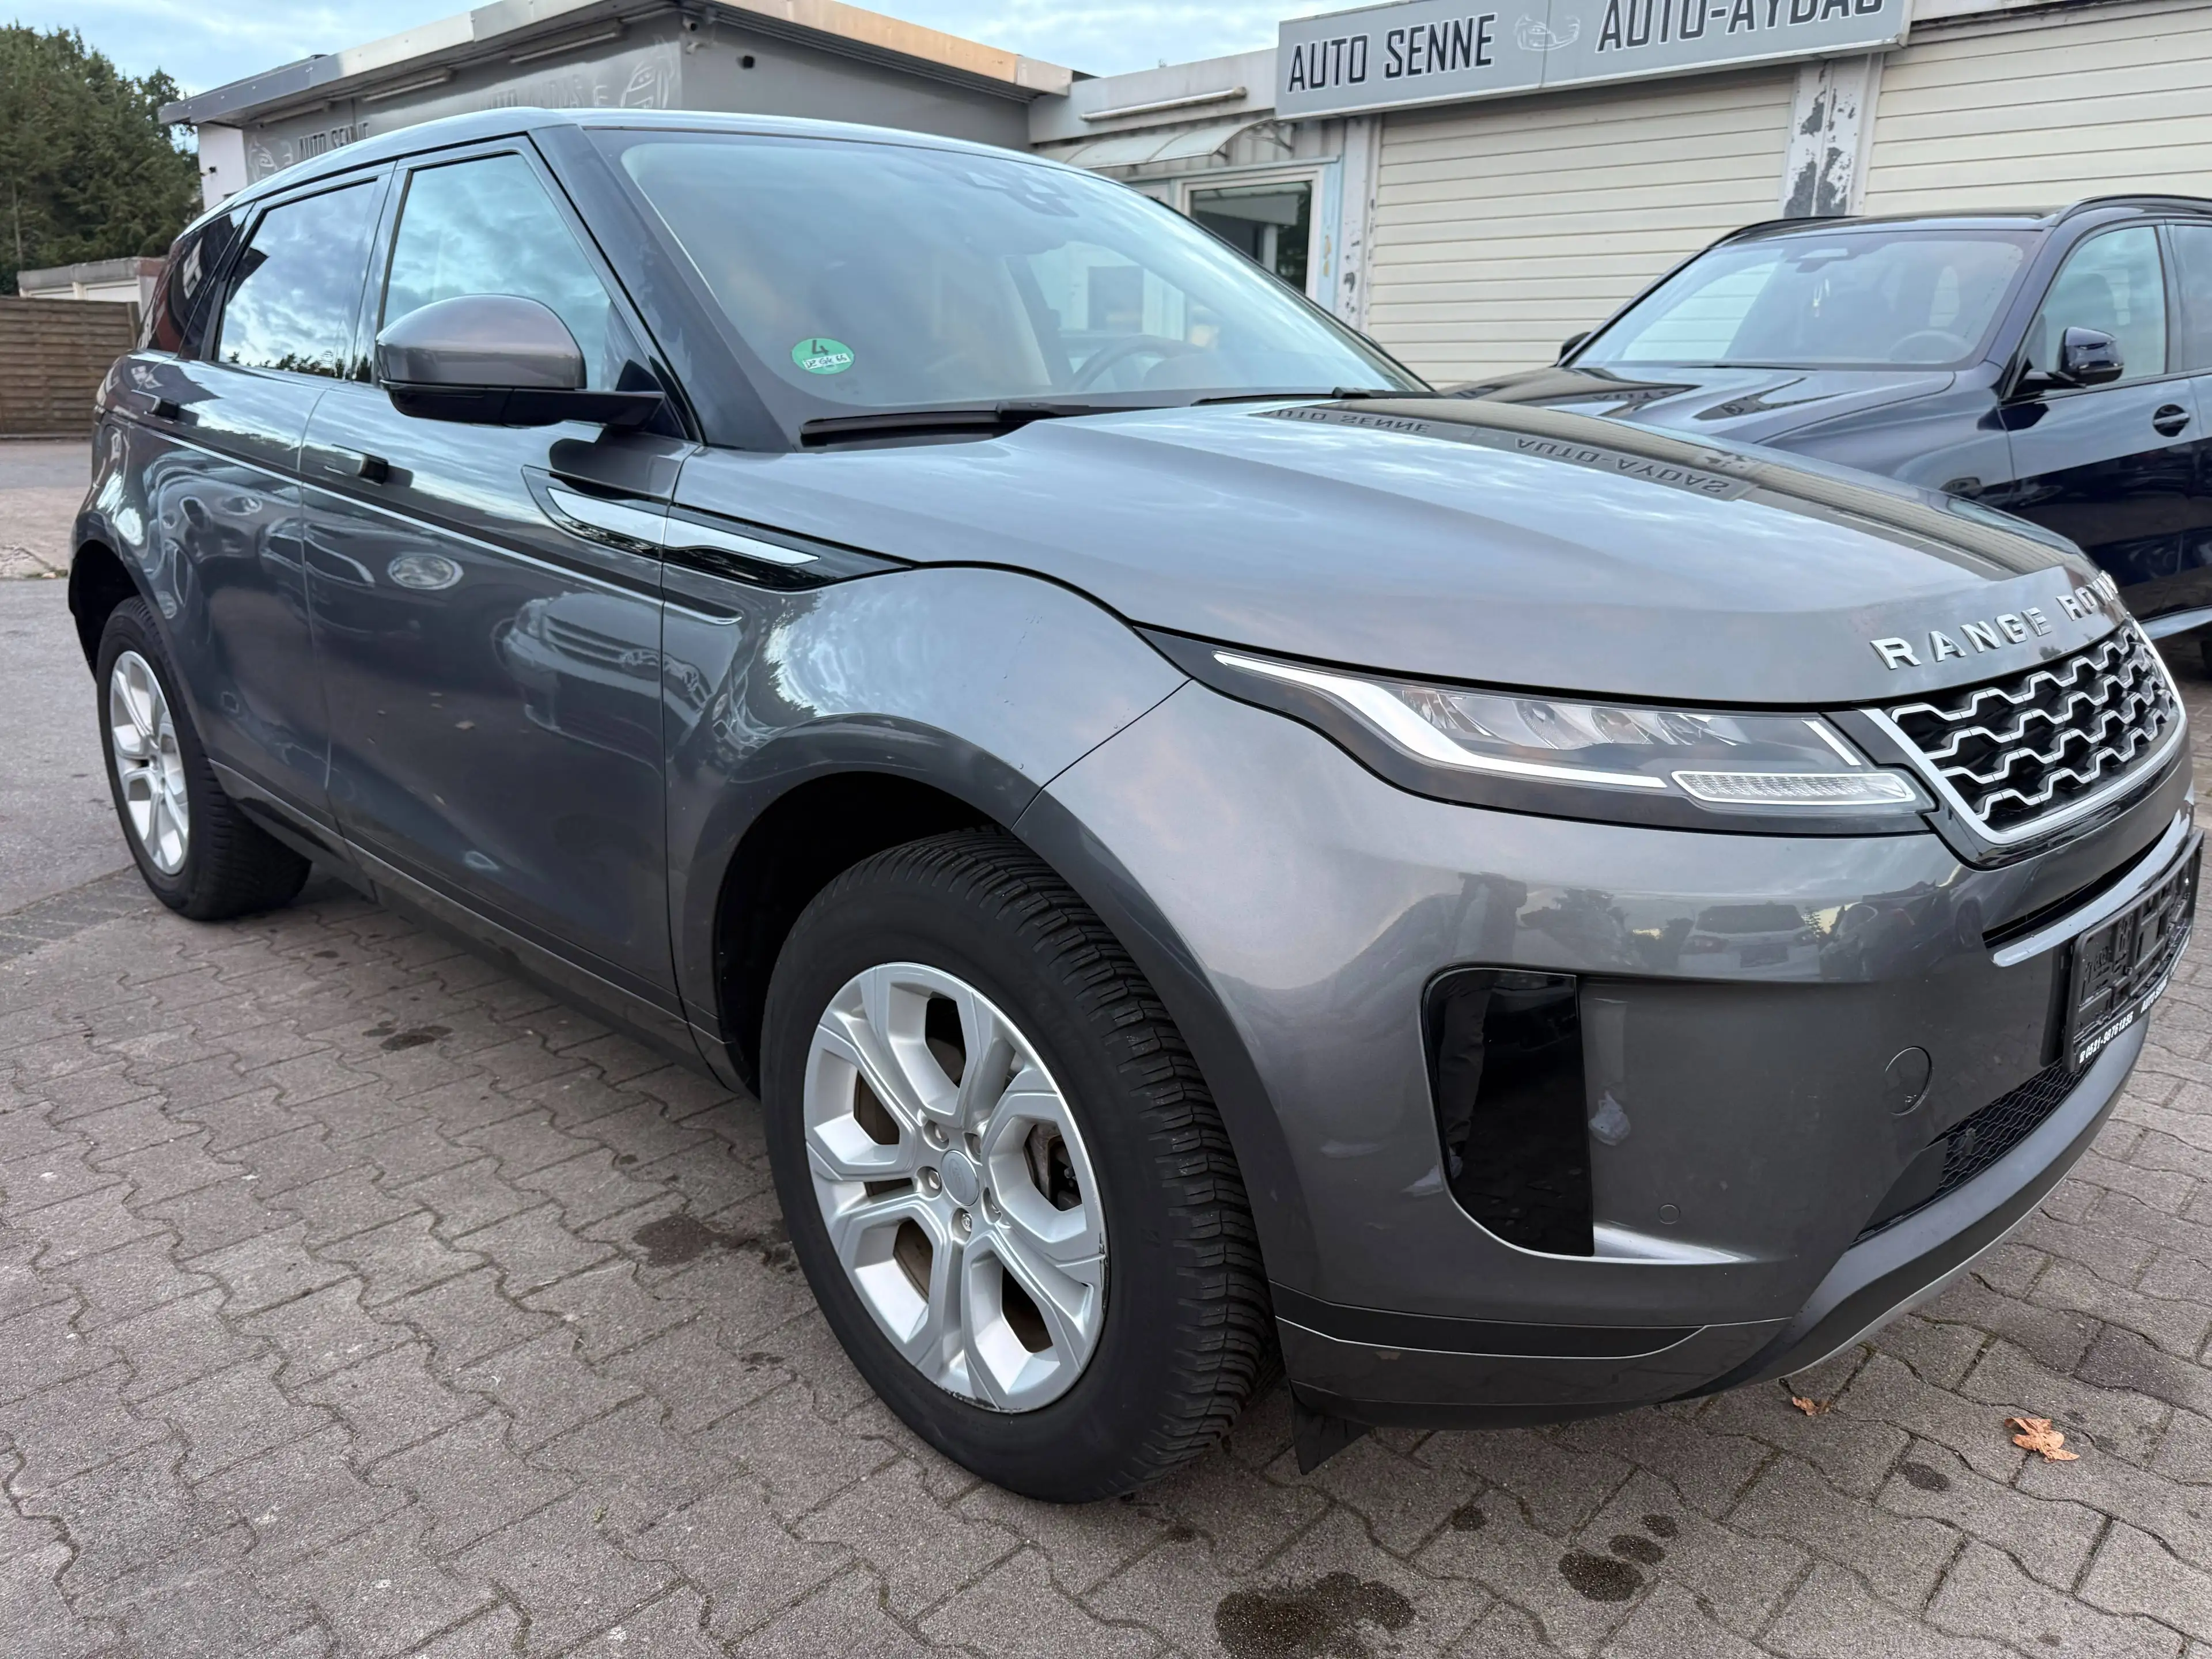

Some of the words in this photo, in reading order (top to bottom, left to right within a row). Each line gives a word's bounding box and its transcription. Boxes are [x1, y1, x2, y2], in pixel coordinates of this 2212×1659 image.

[1287, 34, 1370, 93] AUTO
[1384, 13, 1498, 79] SENNE
[812, 339, 830, 355] 4
[1870, 607, 2052, 670] RANGE
